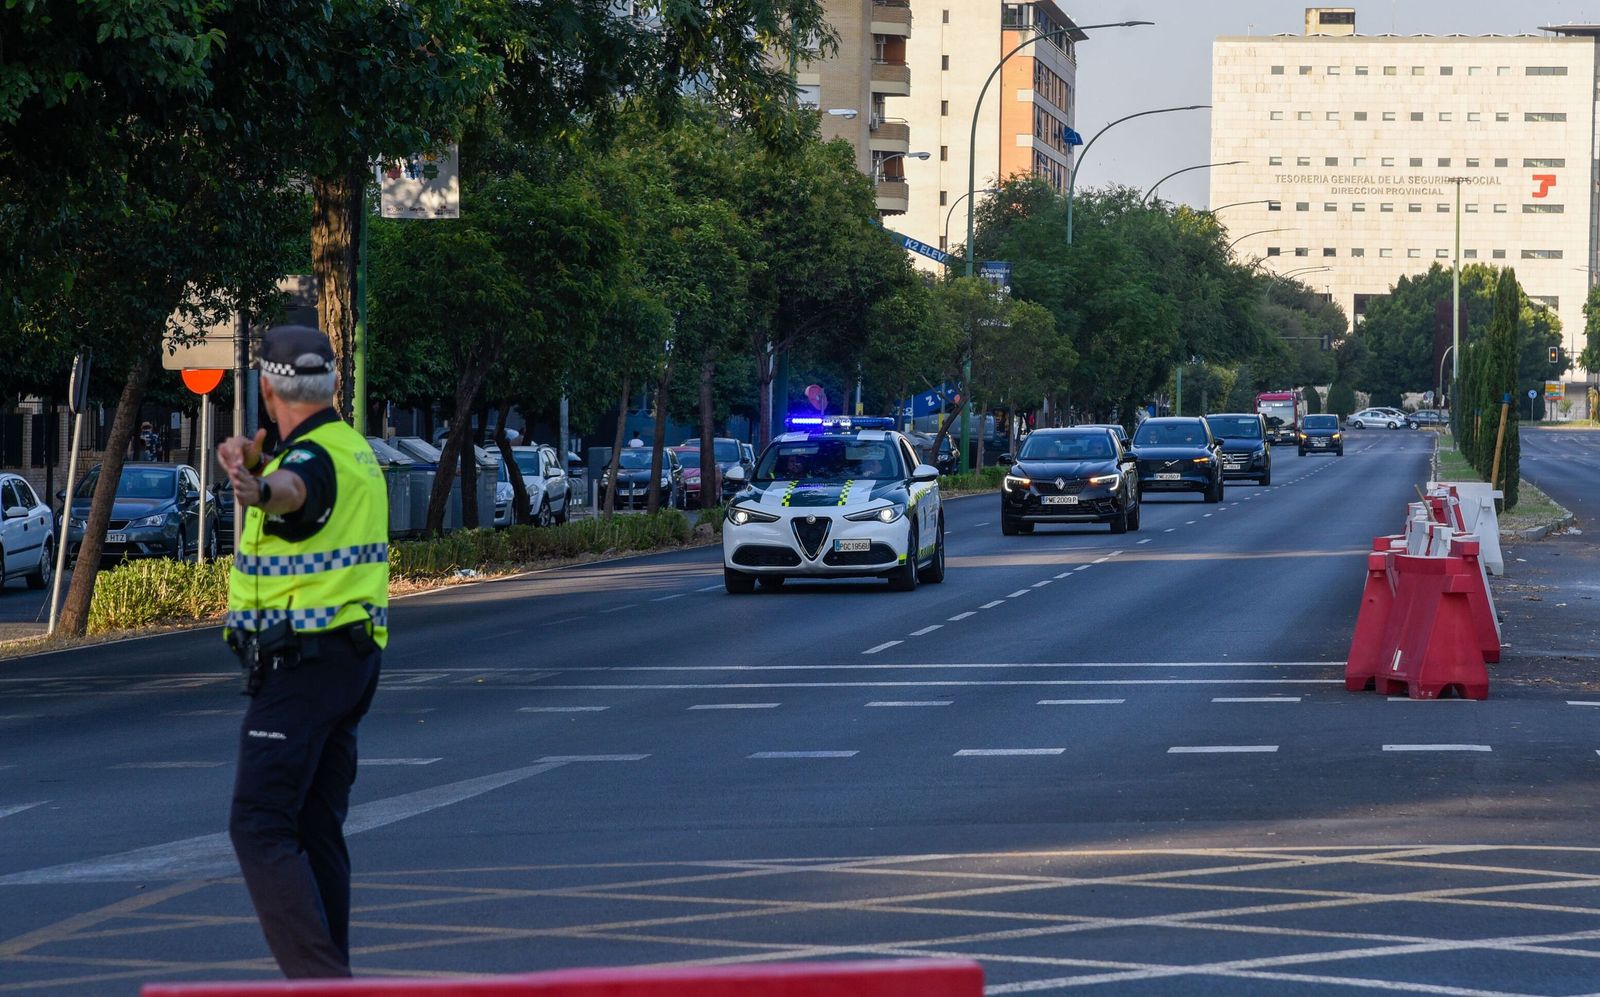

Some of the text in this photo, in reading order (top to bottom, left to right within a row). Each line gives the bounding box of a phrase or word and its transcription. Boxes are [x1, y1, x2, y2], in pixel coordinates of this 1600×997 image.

[1275, 174, 1329, 184] TESORERIA
[1331, 174, 1376, 184] GENERAL
[1378, 175, 1391, 185] DE
[1393, 175, 1404, 185] LA
[1466, 175, 1502, 185] SOCIAL
[1331, 186, 1445, 196] DIRECCION PROVINCIAL
[905, 238, 946, 262] K2 ELEV
